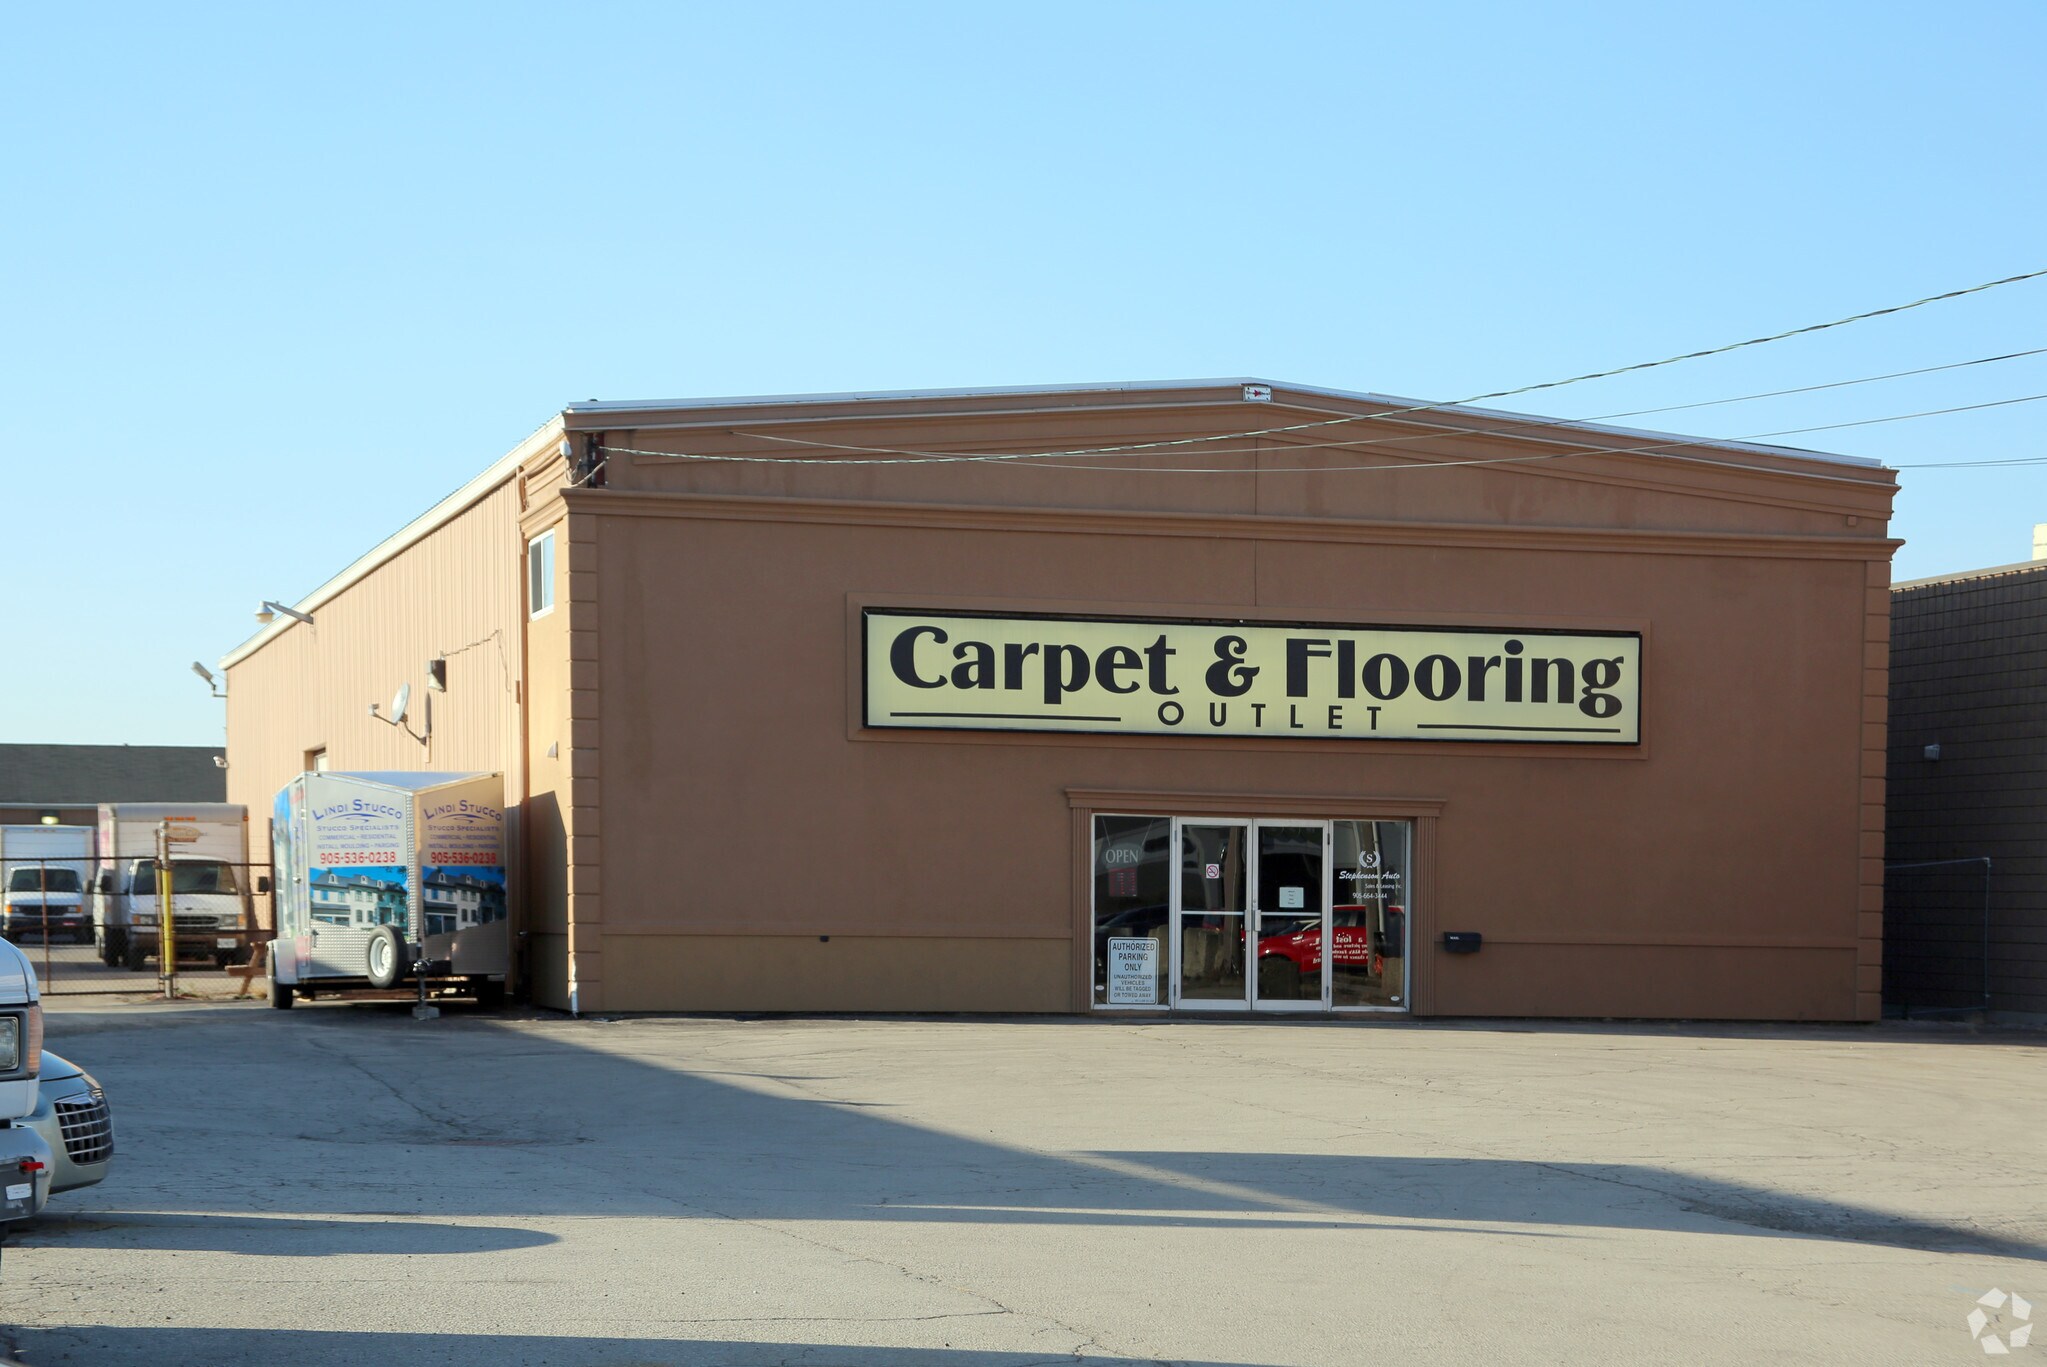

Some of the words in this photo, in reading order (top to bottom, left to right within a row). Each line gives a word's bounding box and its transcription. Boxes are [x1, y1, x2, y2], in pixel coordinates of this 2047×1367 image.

[890, 625, 1180, 705] Carpet
[1205, 635, 1260, 697] &
[1286, 638, 1624, 718] Flooring
[1158, 701, 1382, 730] OUTLET
[312, 804, 348, 820] LINDI
[352, 799, 402, 819] STUCCO
[424, 804, 455, 820] LINDI
[459, 800, 502, 821] STUCCO
[320, 851, 396, 864] 905-536-0238
[431, 852, 496, 864] 905-536-0238
[1105, 849, 1139, 864] OPEN
[1366, 854, 1373, 863] S
[1339, 870, 1379, 881] Stephenson
[1381, 870, 1400, 879] Auto
